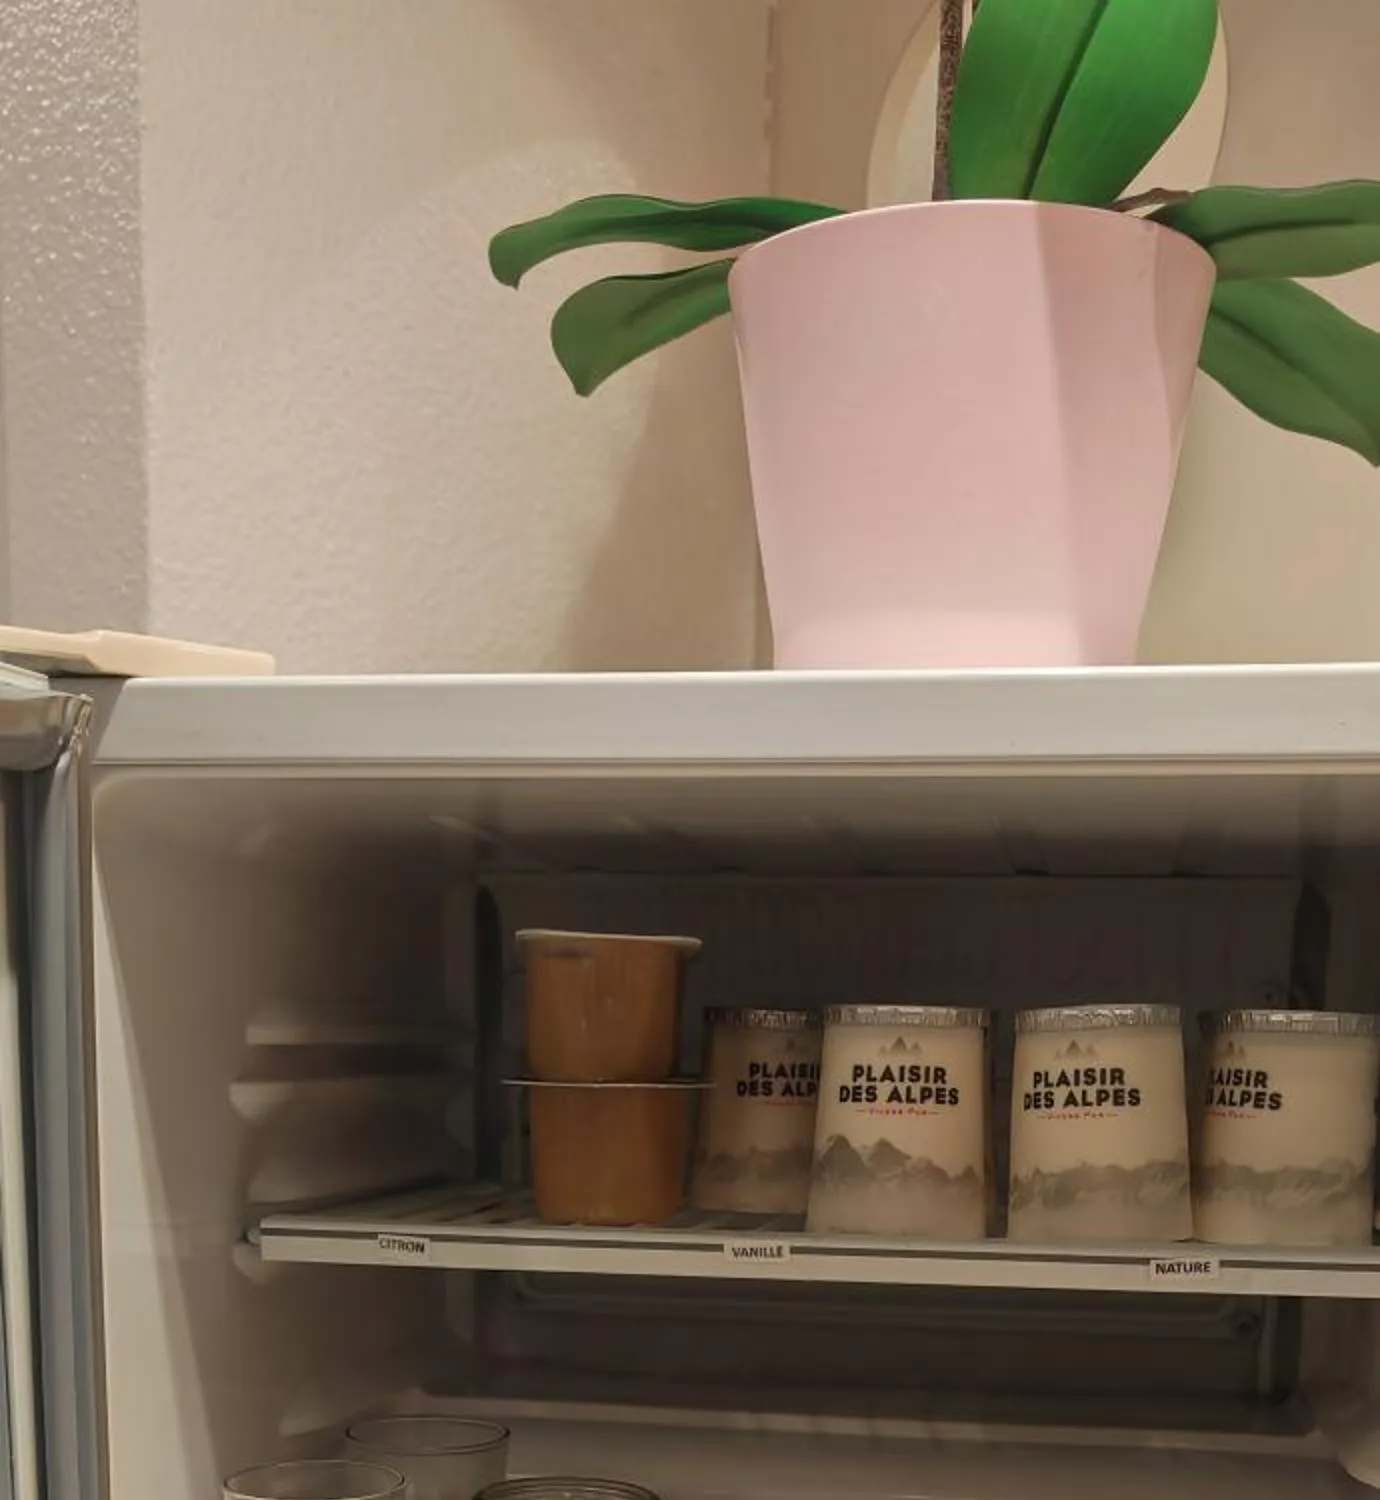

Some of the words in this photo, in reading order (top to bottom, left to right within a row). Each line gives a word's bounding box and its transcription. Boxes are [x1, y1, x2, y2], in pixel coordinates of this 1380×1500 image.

[852, 1065, 947, 1084] PLAISIR
[1033, 1068, 1125, 1089] PLAISIR
[737, 1080, 773, 1098] DES
[781, 1082, 818, 1098] ALP
[839, 1086, 878, 1104] DES
[887, 1087, 959, 1106] ALPES
[1024, 1091, 1055, 1111] DES
[1063, 1088, 1141, 1108] ALPES
[1216, 1088, 1283, 1111] ALPES
[379, 1238, 425, 1253] CITRON
[1155, 1261, 1211, 1275] NATURE
